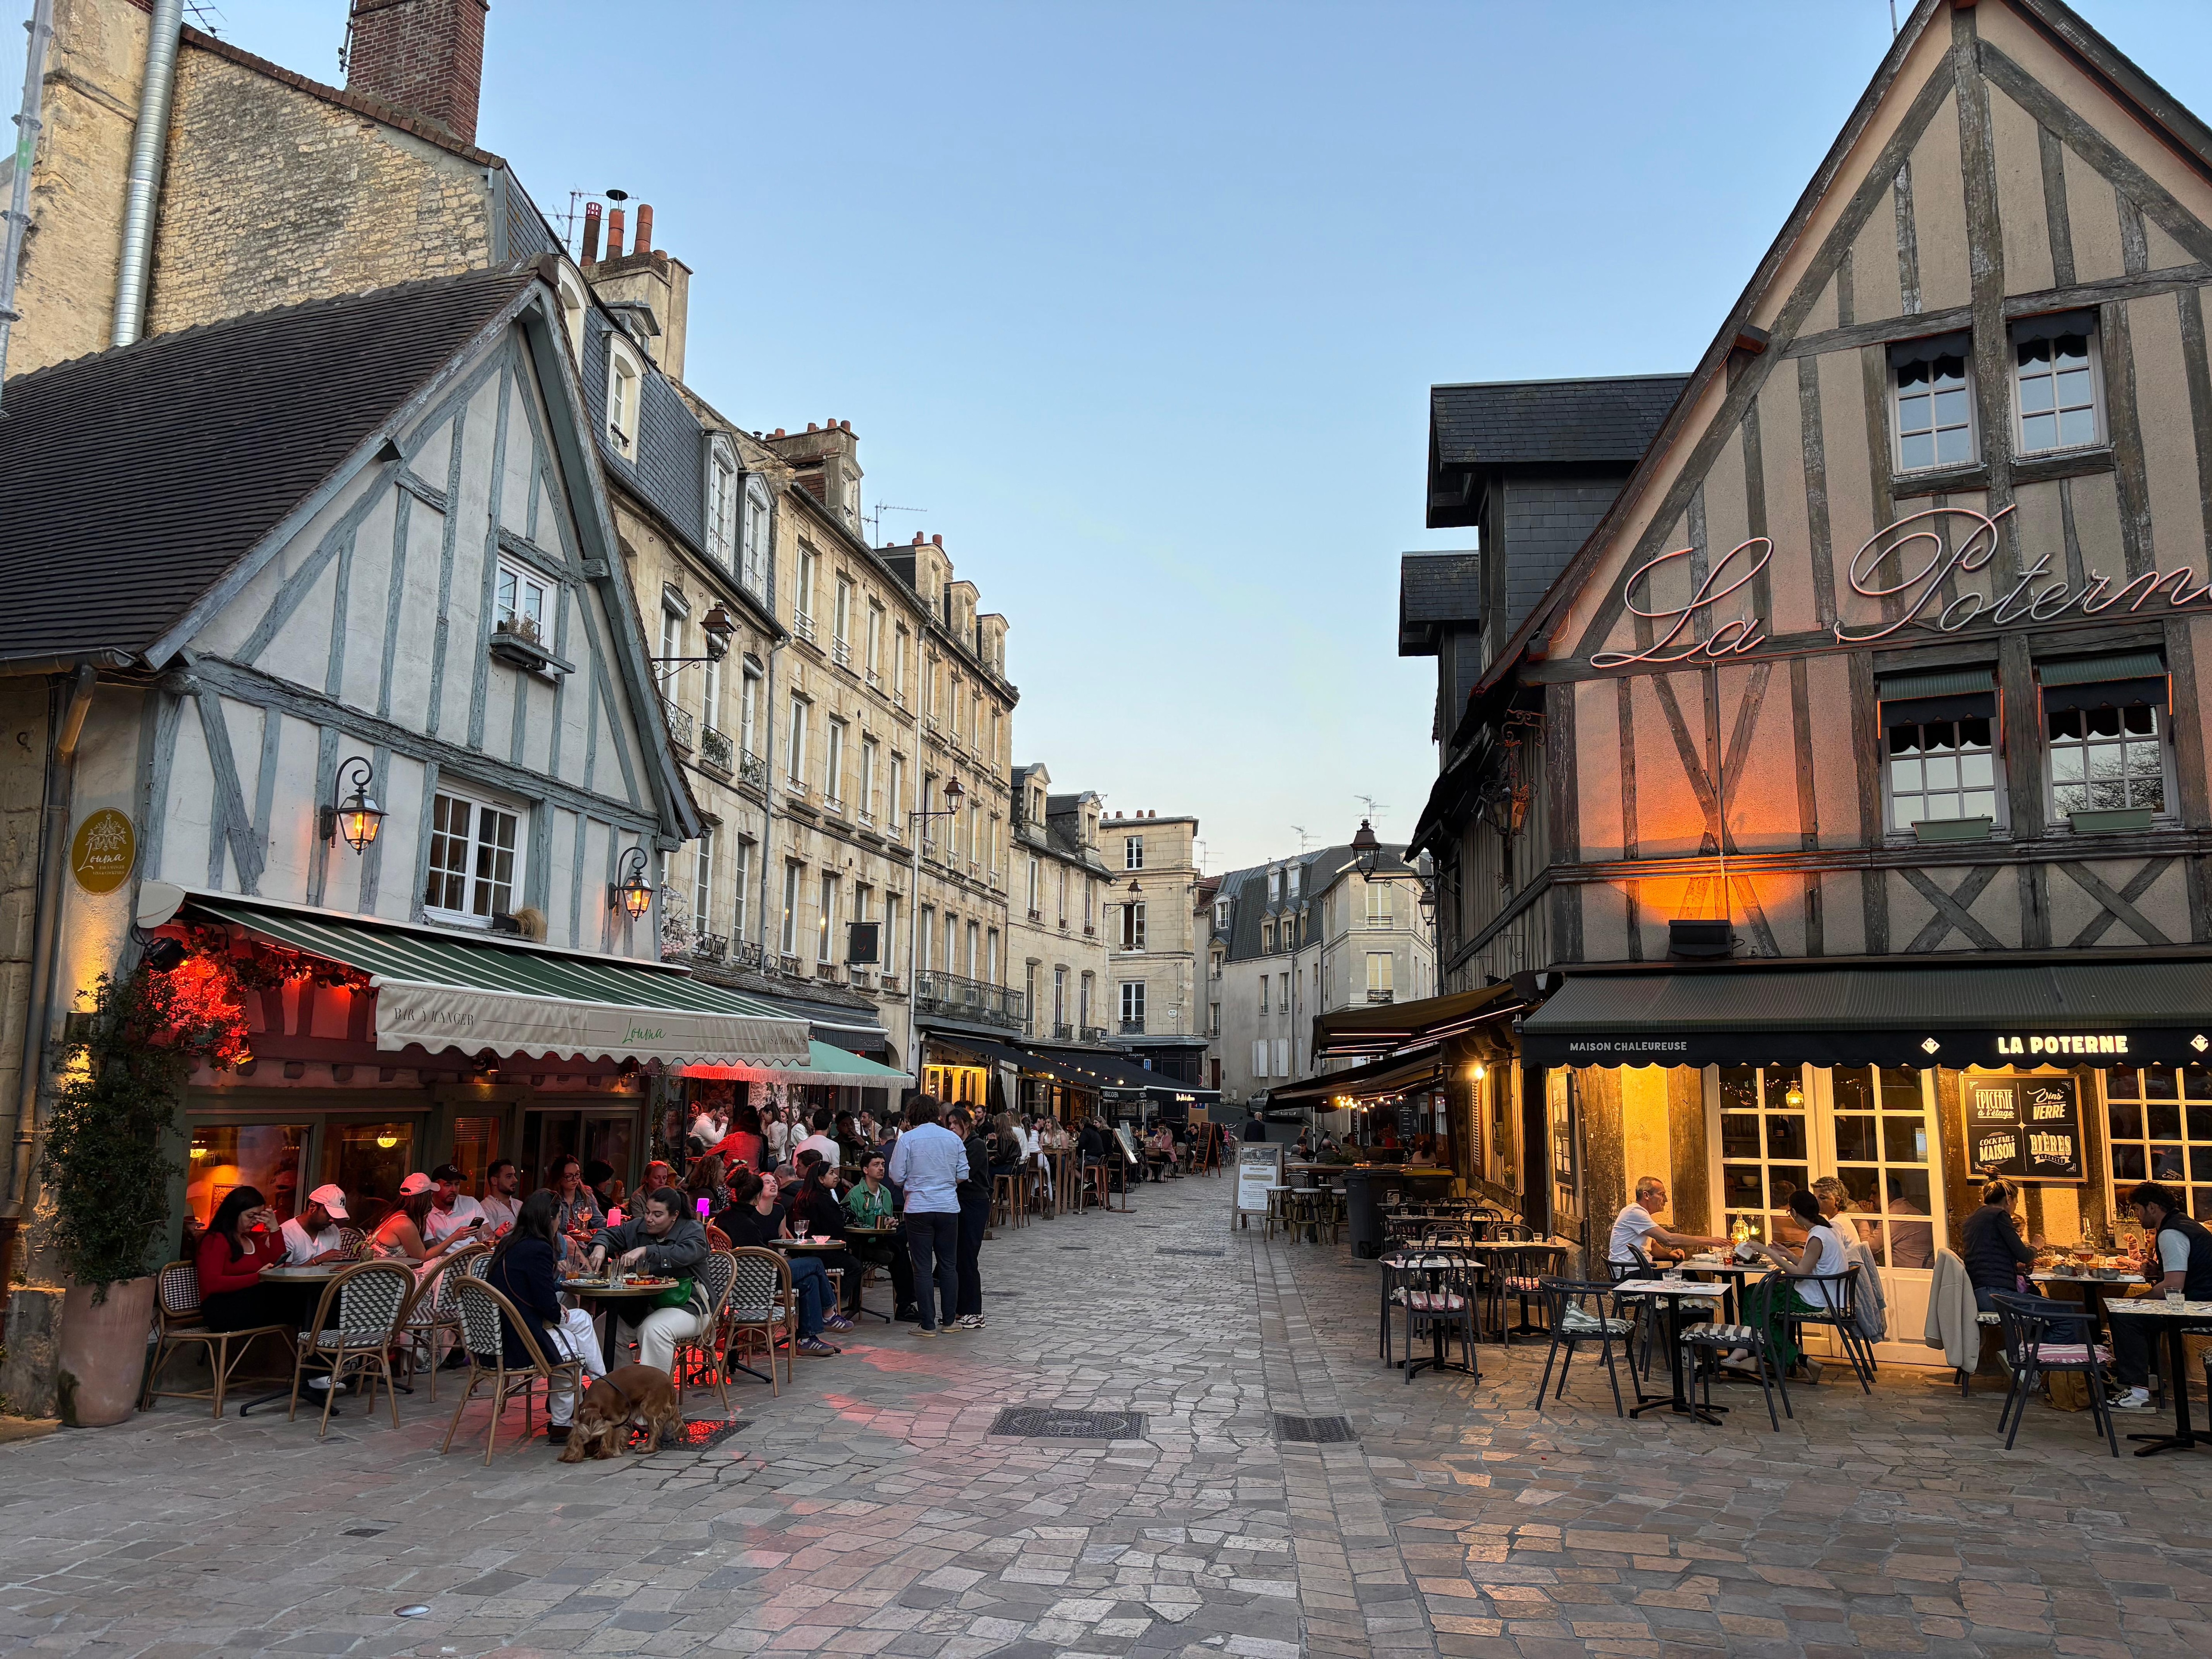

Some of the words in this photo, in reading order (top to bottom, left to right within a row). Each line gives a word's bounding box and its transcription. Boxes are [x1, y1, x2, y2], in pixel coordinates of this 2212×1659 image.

[1590, 537, 1772, 668] La
[1832, 503, 2212, 644] Potern
[77, 842, 126, 872] Louma
[622, 1017, 667, 1044] Louma
[1570, 1042, 1611, 1051] MAISON
[1614, 1041, 1687, 1051] CHALEUREUSE
[1997, 1037, 2024, 1054] LA
[2030, 1035, 2128, 1054] POTERNE
[1975, 1091, 2014, 1110] EPICERIE
[2027, 1088, 2065, 1103] Vins
[2033, 1103, 2066, 1120] VERRE
[1979, 1135, 2015, 1146] COCKTAILS
[2029, 1131, 2072, 1156] BIÈRES
[1979, 1142, 2016, 1162] MAISON
[2041, 1154, 2064, 1164] LOCALES
